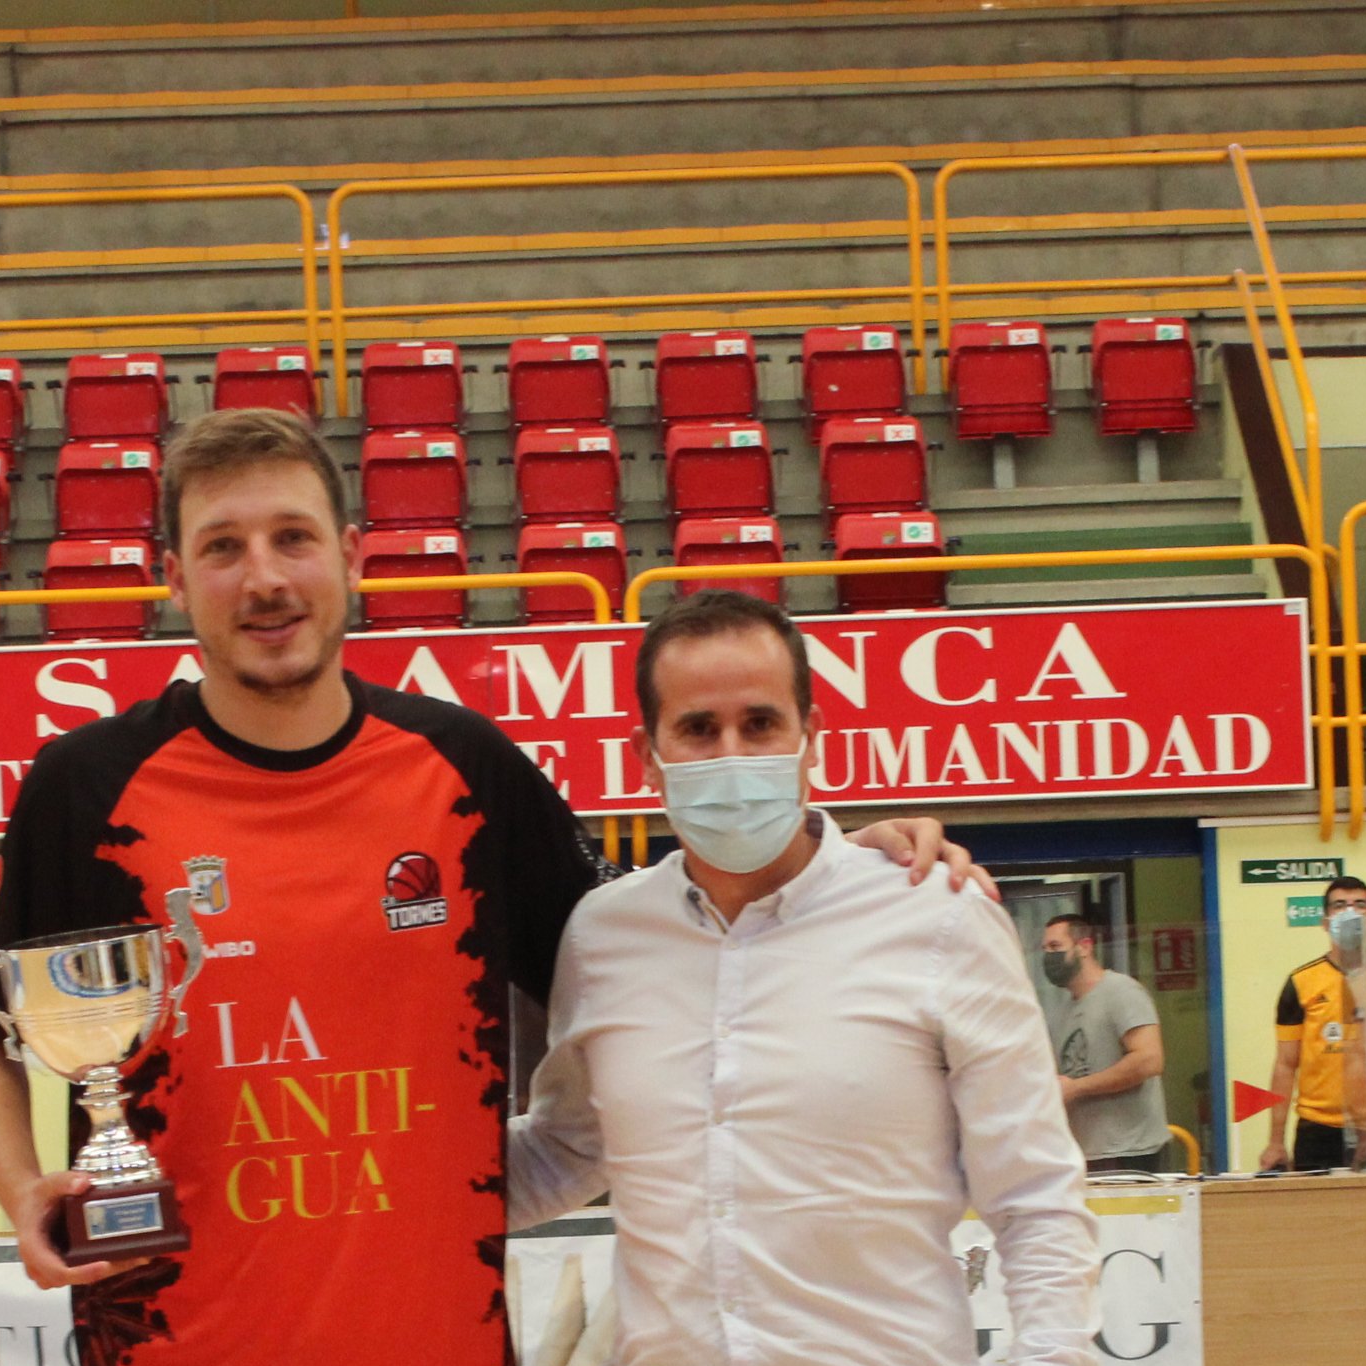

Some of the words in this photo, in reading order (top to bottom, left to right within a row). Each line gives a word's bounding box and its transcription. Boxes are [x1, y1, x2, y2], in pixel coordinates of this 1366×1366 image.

[808, 713, 1272, 792] UMANIDAD
[1276, 862, 1338, 880] SALIDA
[209, 996, 329, 1068] LA
[222, 1067, 435, 1146] ANTI-
[226, 1148, 395, 1222] GUA
